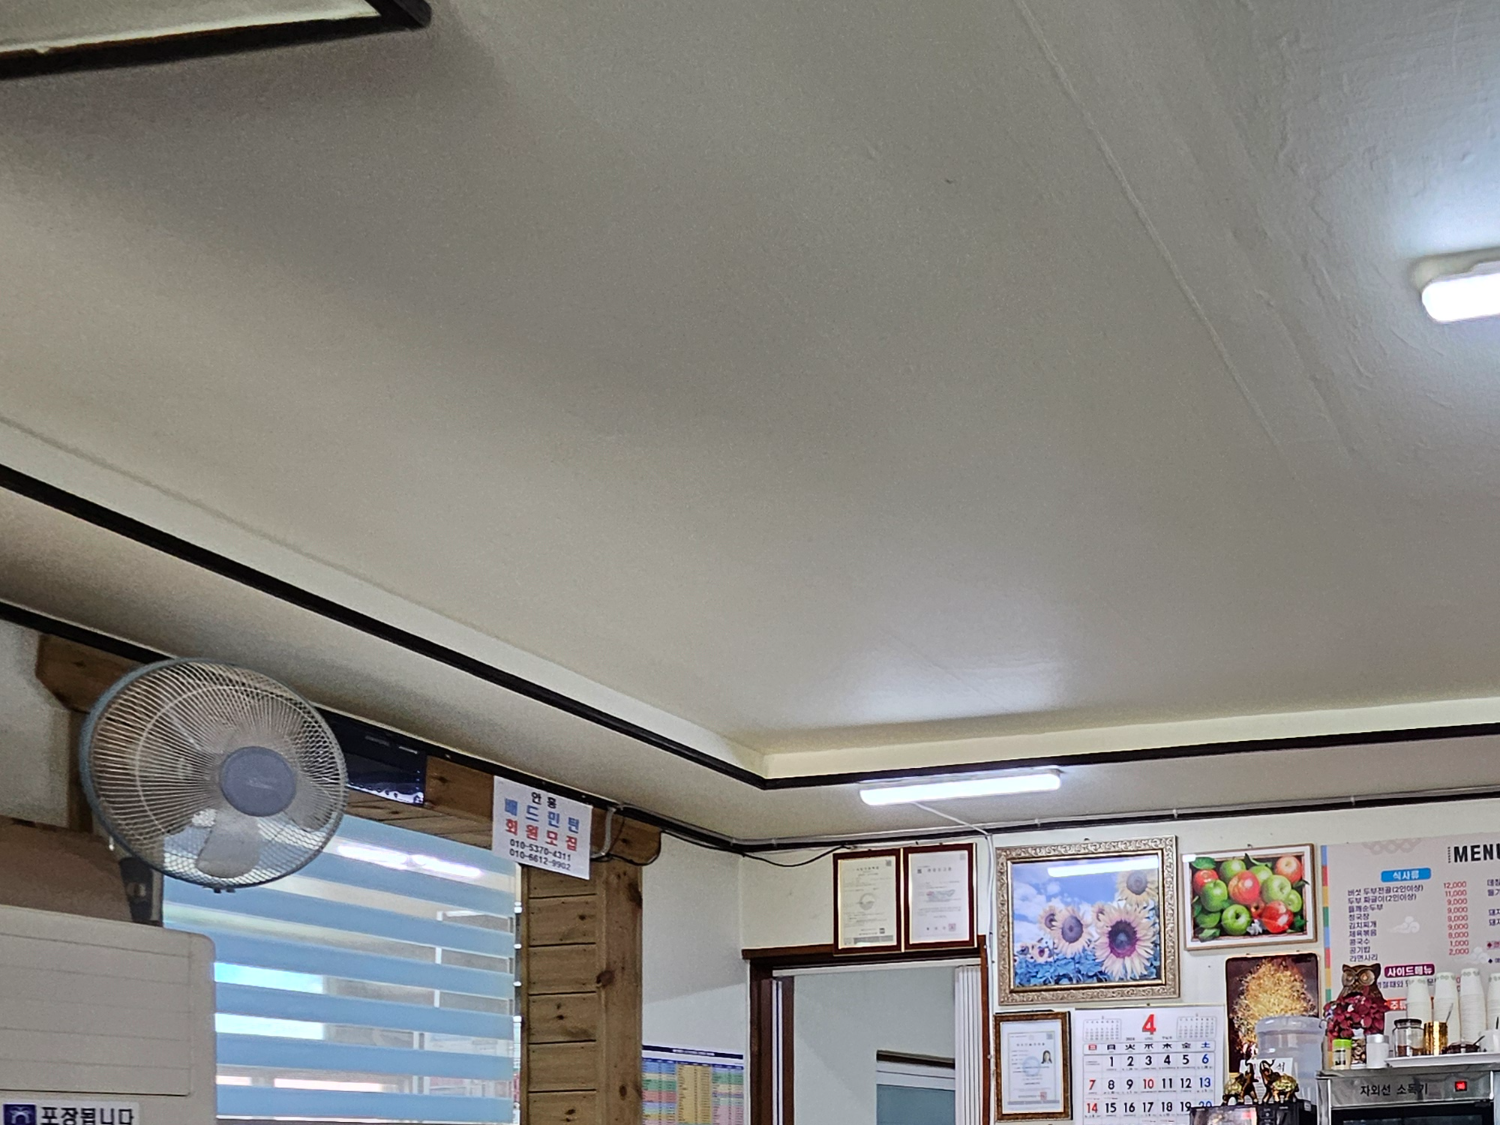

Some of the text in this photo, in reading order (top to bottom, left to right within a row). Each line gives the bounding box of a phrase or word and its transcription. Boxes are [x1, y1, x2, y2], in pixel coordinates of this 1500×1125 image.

[504, 798, 579, 834] 배드민턴
[505, 819, 577, 851] 회원모집
[510, 838, 571, 861] 010-5370-4311
[1393, 870, 1419, 880] 식사류
[1443, 881, 1467, 889] 12,000
[1387, 966, 1432, 976] 사이드메뉴
[1142, 1014, 1156, 1035] 4
[1110, 1054, 1209, 1067] 1 2 3 4 5 6
[1089, 1077, 1211, 1090] 7 8 9 10 11 12 13
[1360, 1083, 1428, 1097] 자외선 소독기
[1087, 1102, 1098, 1113] 14
[1105, 1102, 1116, 1113] 15
[1123, 1102, 1135, 1112] 16
[1142, 1102, 1154, 1112] 17
[1161, 1102, 1172, 1112] 18
[1180, 1101, 1191, 1112] 19
